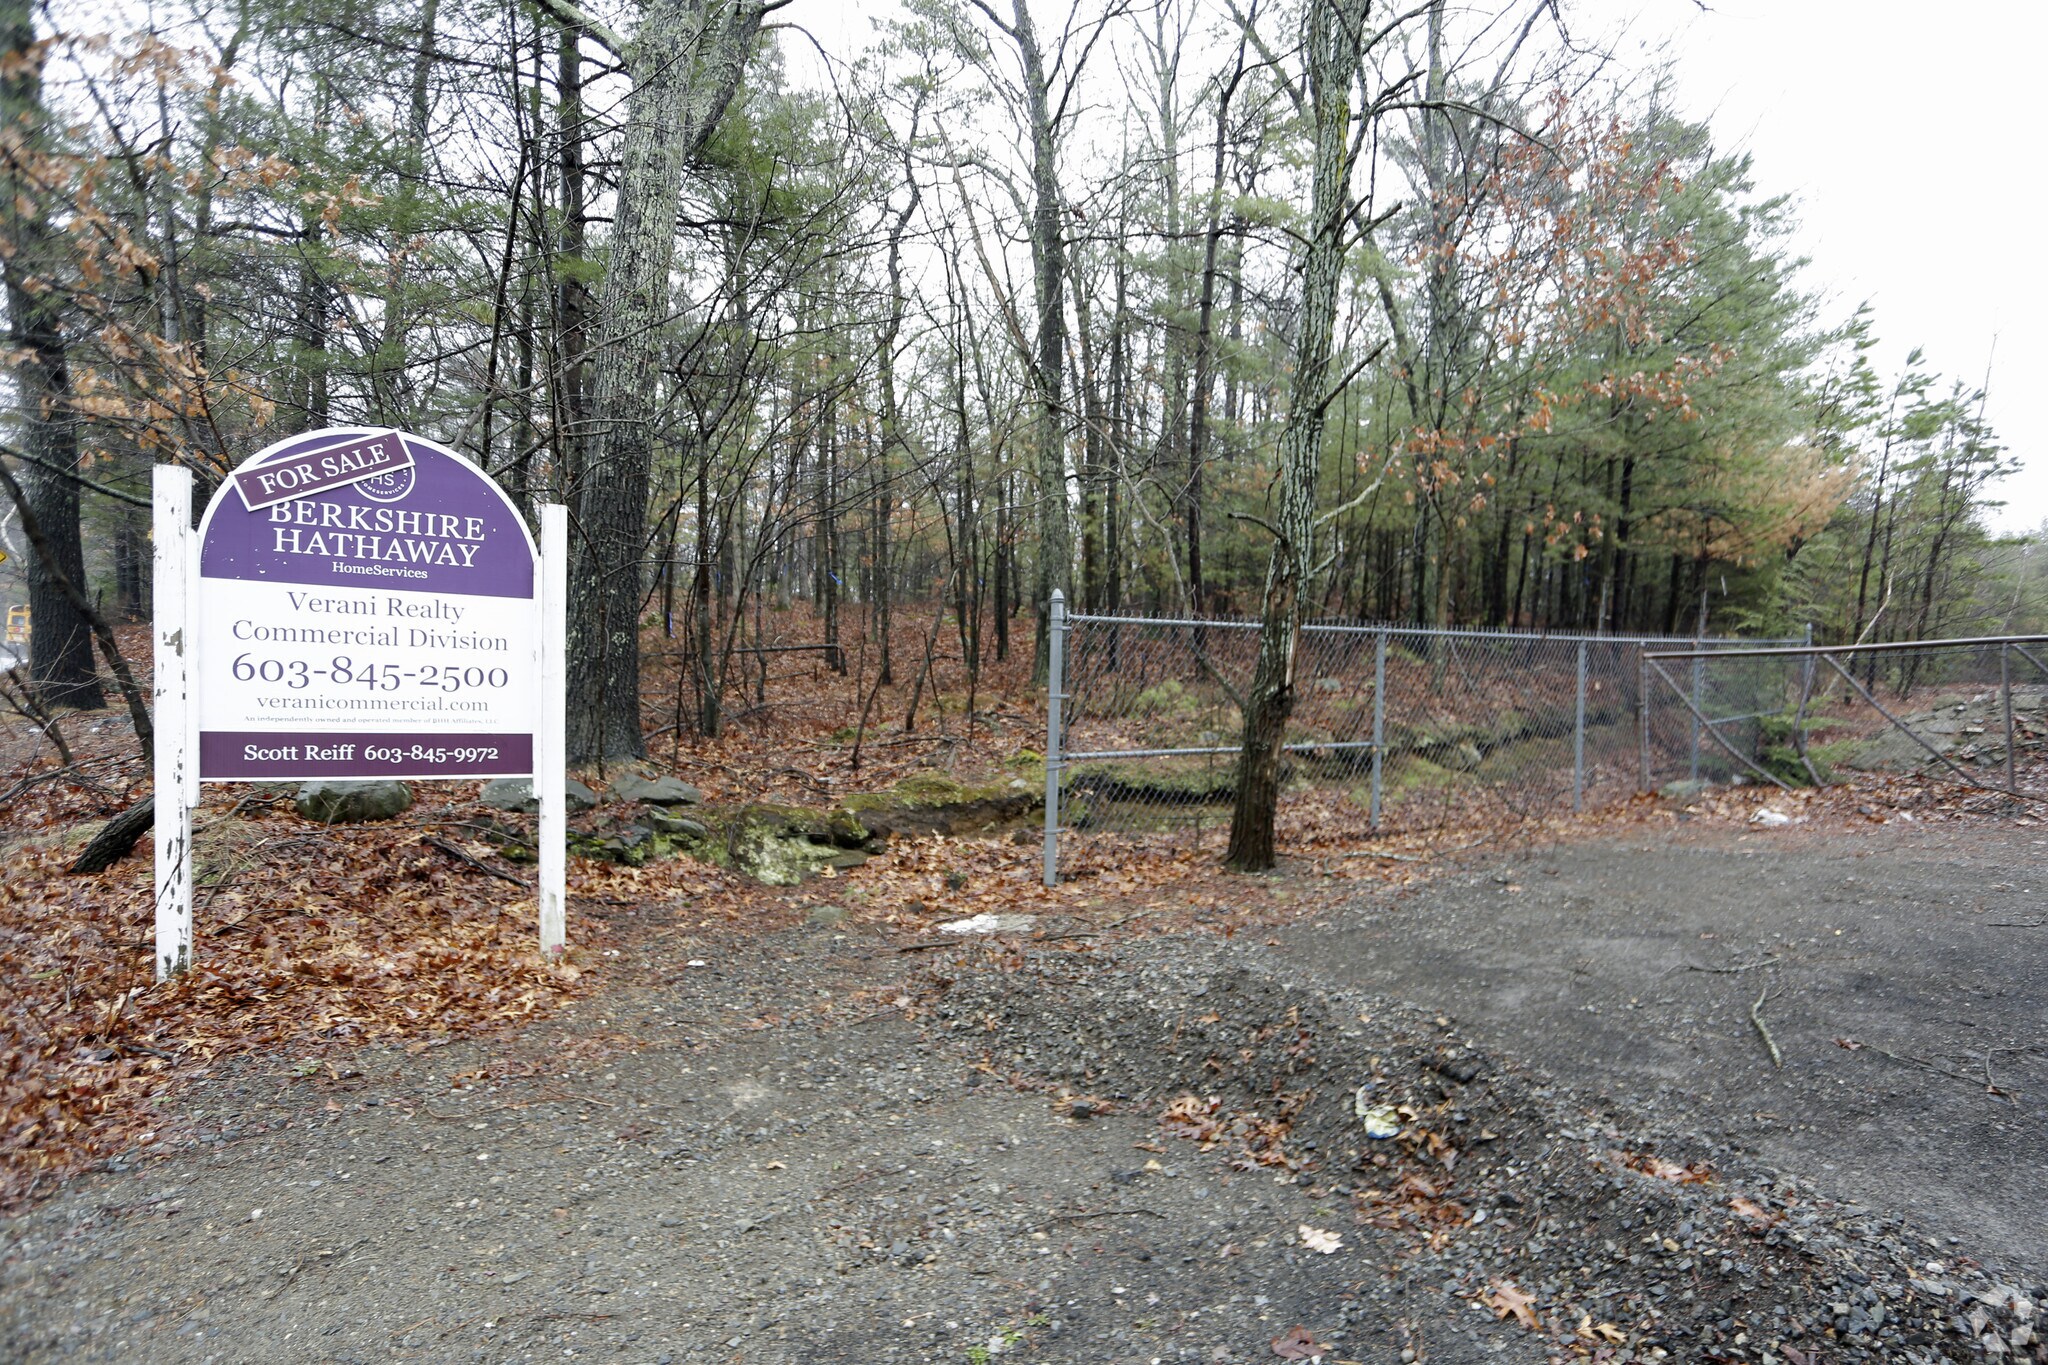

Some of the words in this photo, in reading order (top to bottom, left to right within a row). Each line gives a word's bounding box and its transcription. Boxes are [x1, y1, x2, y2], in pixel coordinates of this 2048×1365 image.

[257, 463, 321, 495] FOR
[321, 443, 390, 478] SALE
[268, 501, 486, 541] BERKSHIRE
[273, 527, 480, 568] HATHAWAY
[332, 561, 428, 579] HomeServices
[286, 591, 377, 616] Verani
[387, 597, 465, 625] Realty
[232, 619, 399, 647] Commercial
[409, 628, 508, 651] Division
[232, 652, 509, 693] 603-845-2500
[257, 694, 489, 712] veranicommercial.com
[257, 715, 313, 723] independently
[243, 744, 299, 761] Scott
[304, 744, 355, 761] Reiff
[363, 744, 499, 763] 603-845-9972
